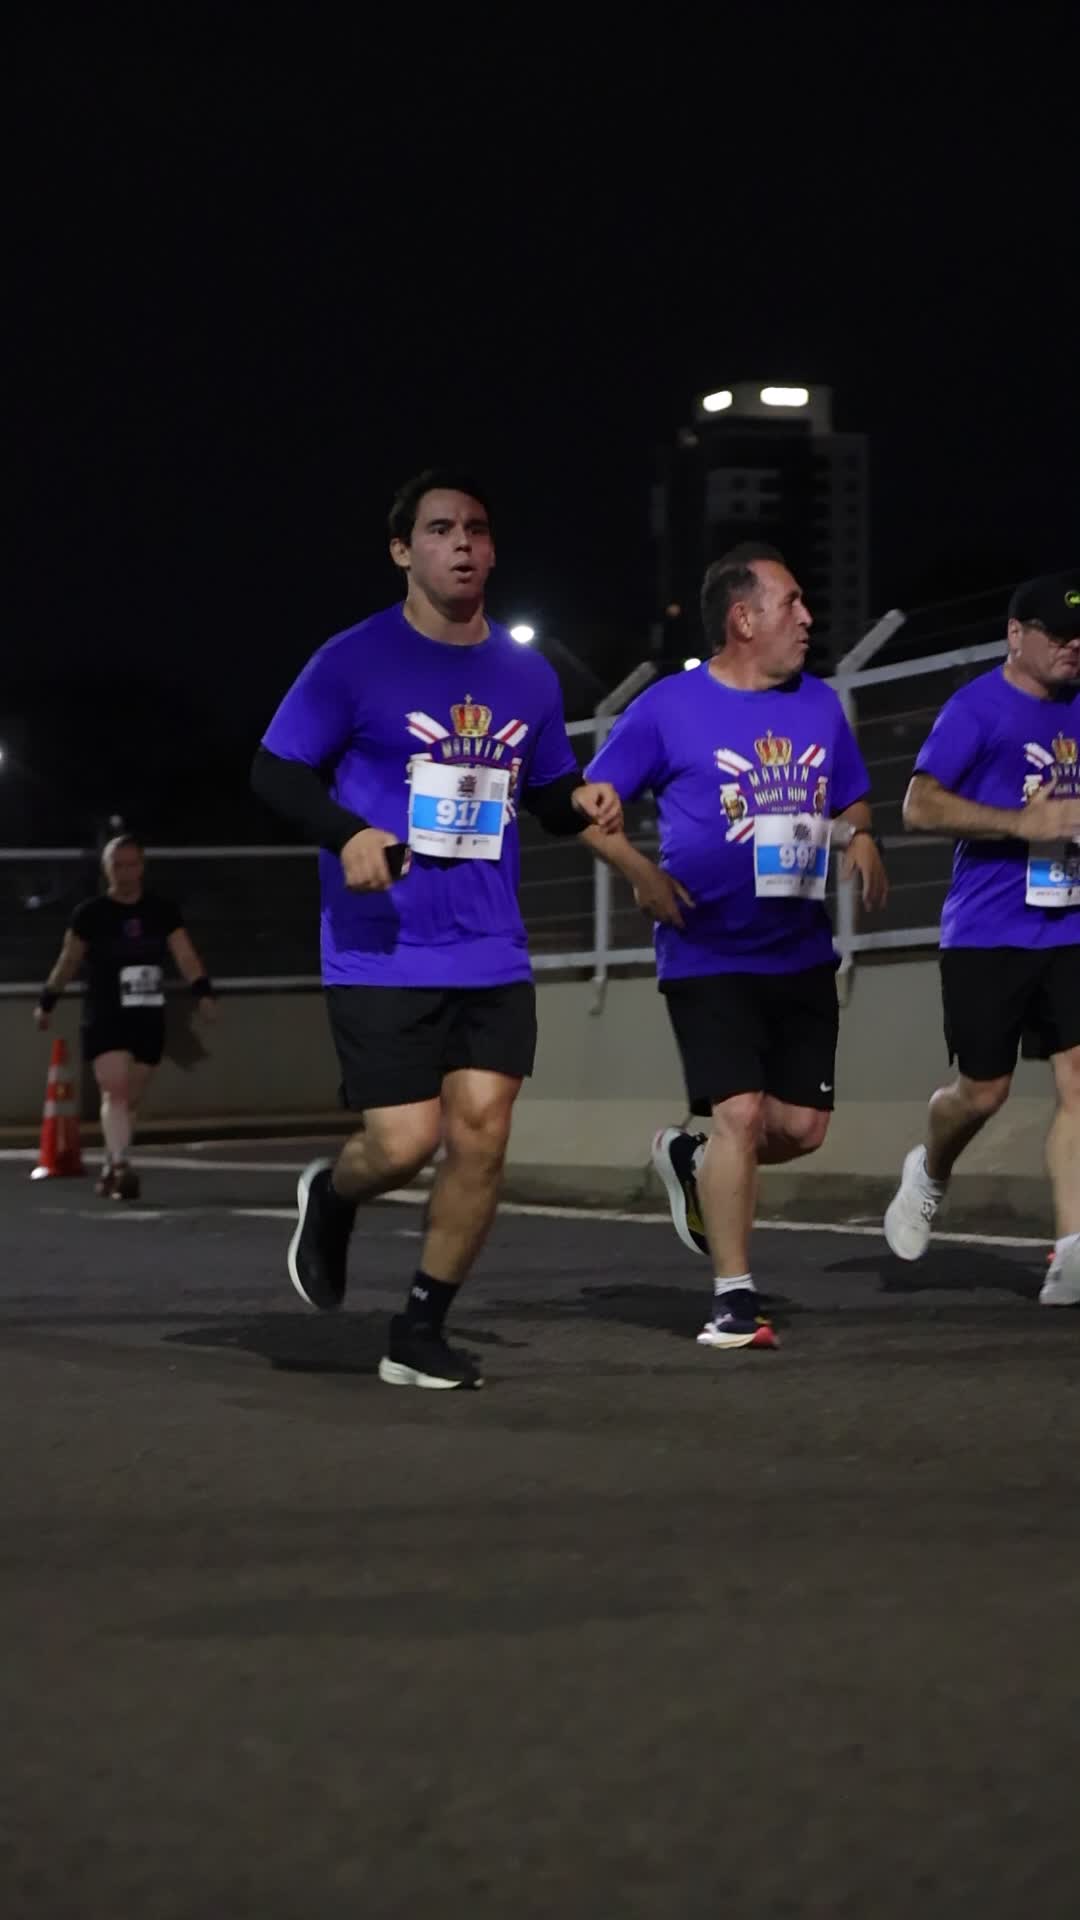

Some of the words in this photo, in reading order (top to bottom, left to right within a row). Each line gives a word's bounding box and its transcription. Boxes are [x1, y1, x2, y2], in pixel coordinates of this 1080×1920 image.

[442, 737, 505, 760] MARVIN
[748, 765, 810, 786] MARVIN
[754, 787, 783, 807] NIGHT
[787, 787, 808, 801] RUN
[436, 799, 481, 826] 917
